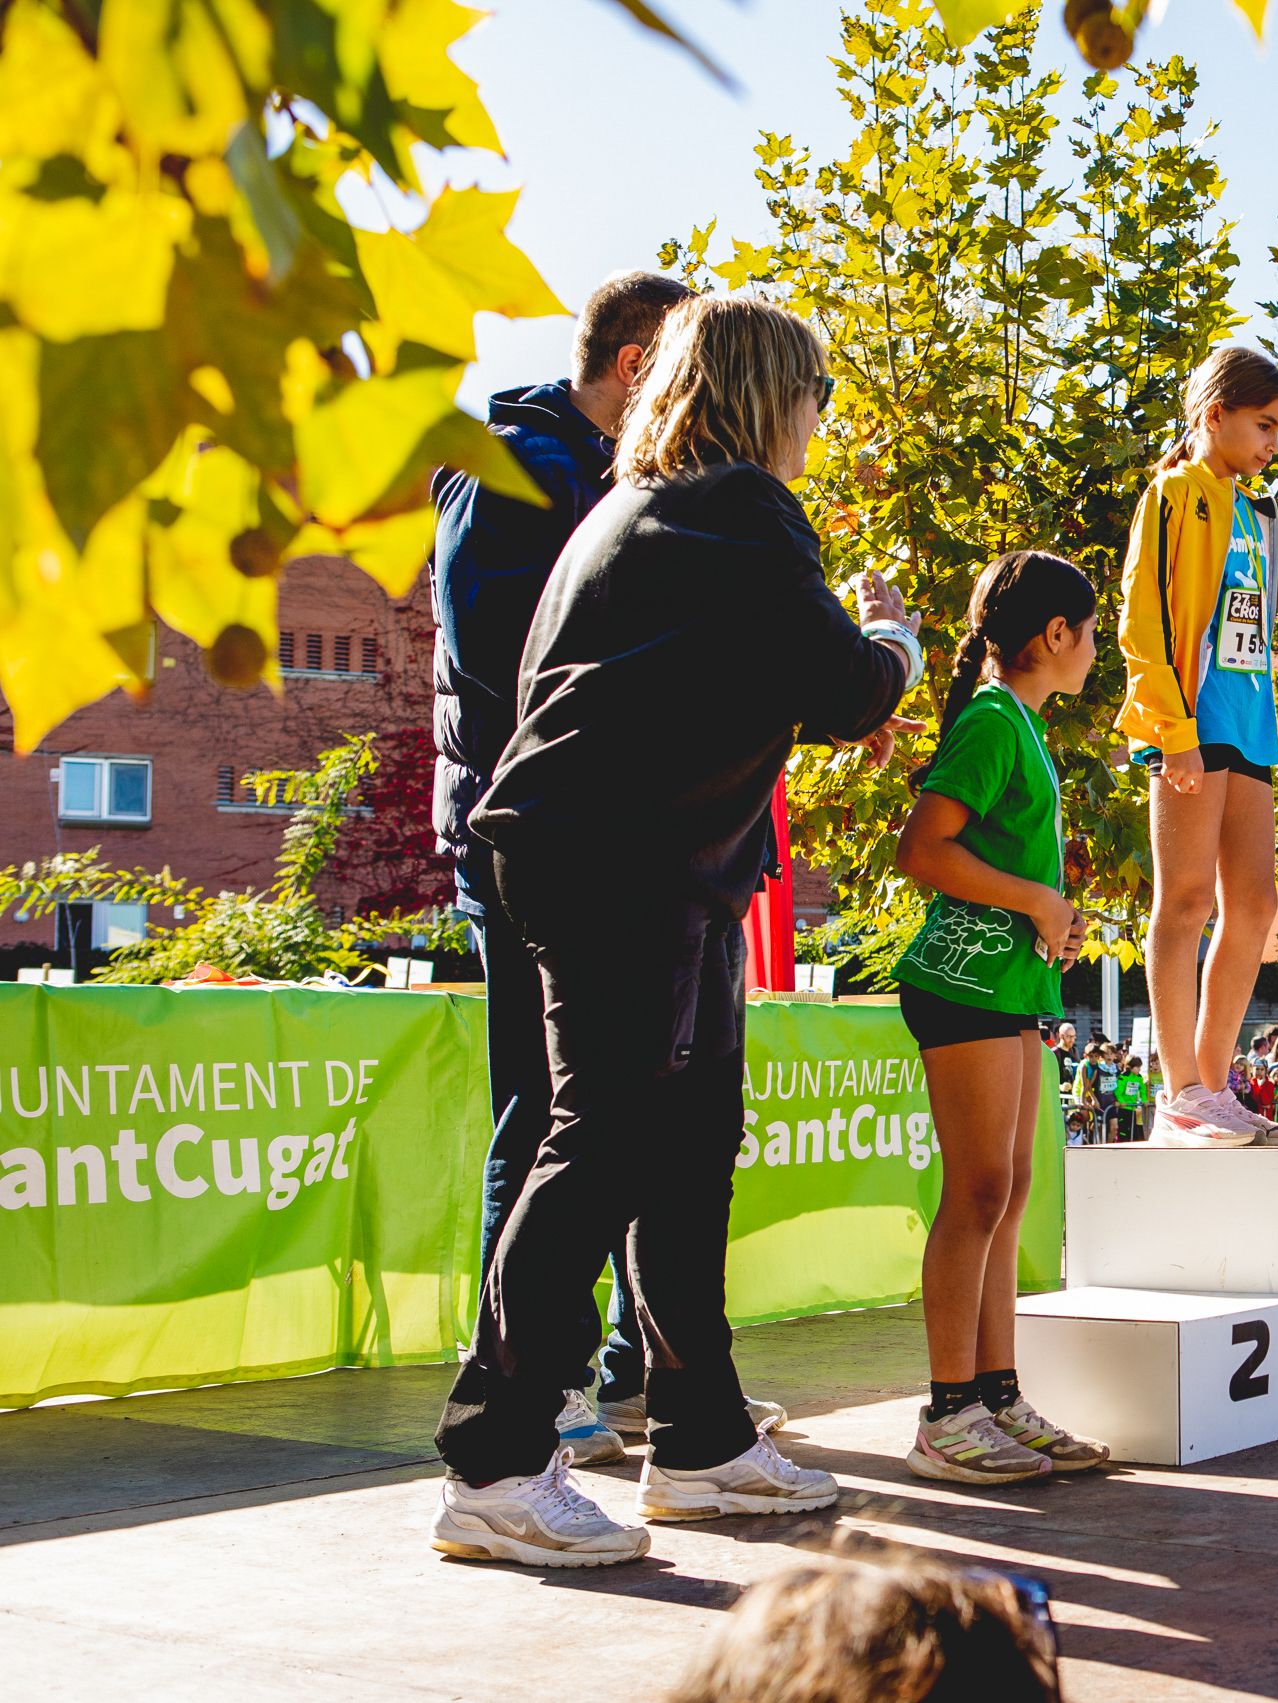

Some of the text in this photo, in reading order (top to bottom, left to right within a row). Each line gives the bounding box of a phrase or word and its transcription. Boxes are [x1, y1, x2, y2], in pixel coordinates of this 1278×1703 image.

[0, 1060, 379, 1118] UNTAMENT DE
[1228, 1319, 1270, 1402] 2
